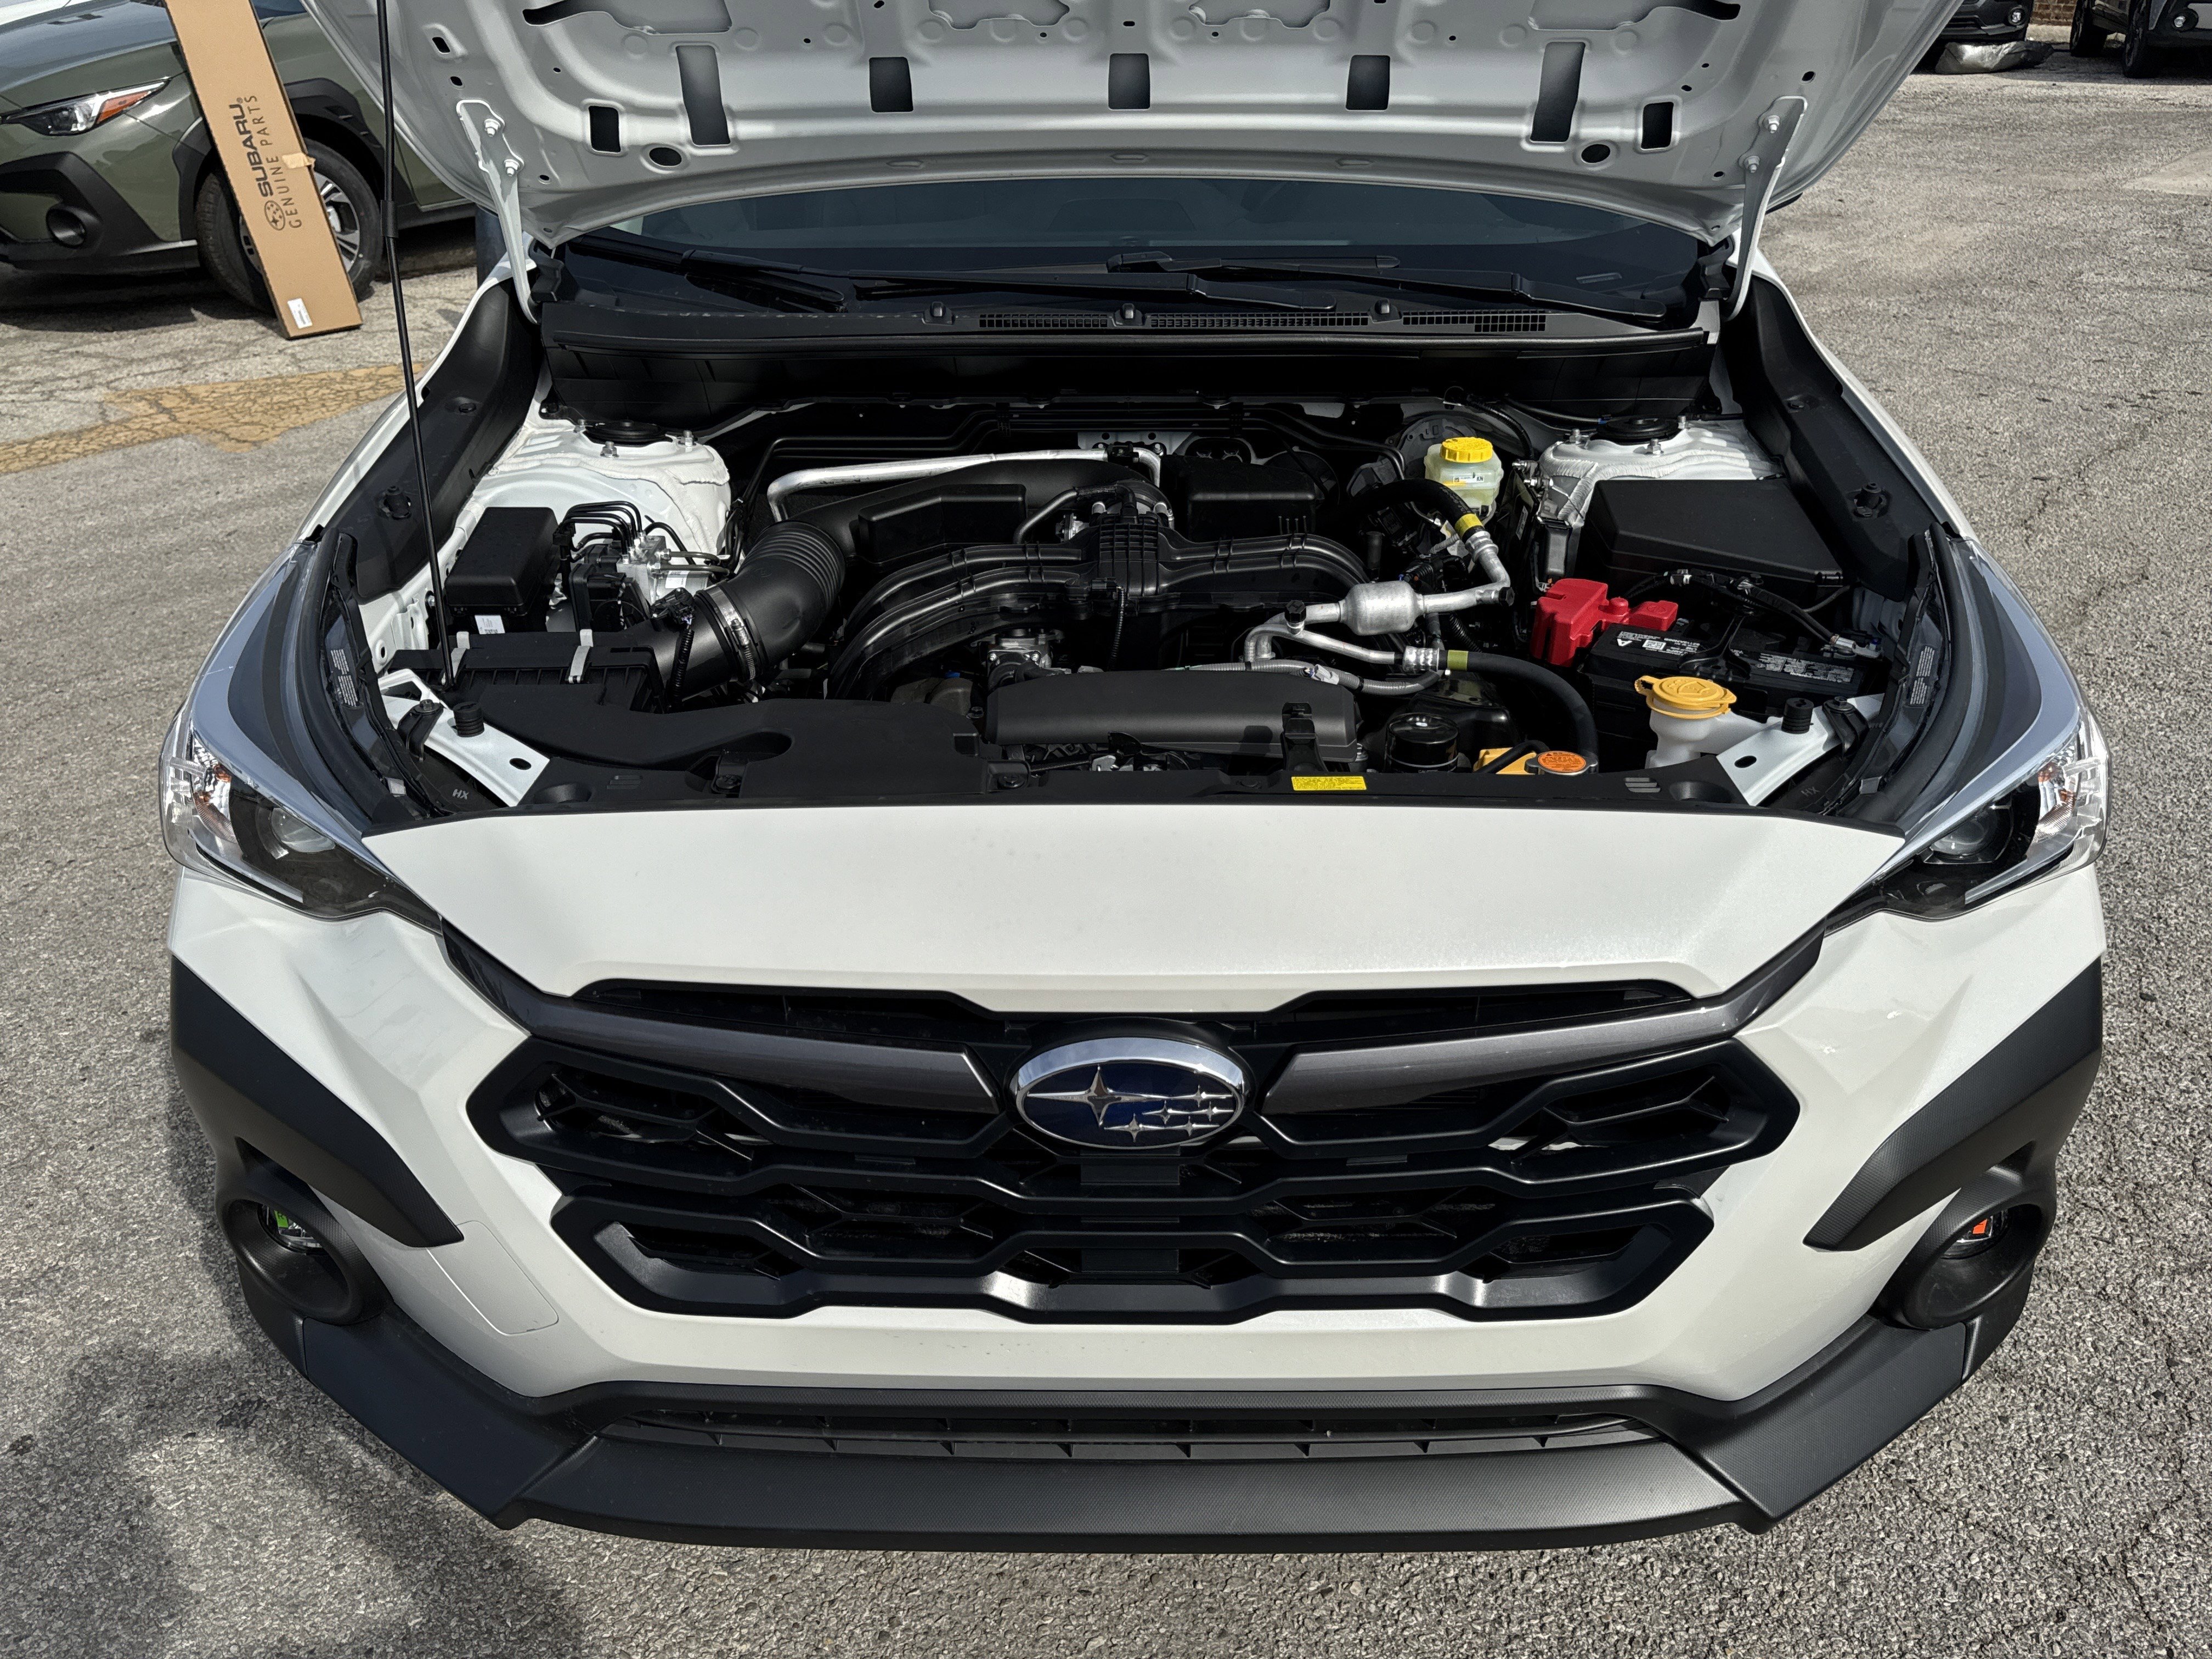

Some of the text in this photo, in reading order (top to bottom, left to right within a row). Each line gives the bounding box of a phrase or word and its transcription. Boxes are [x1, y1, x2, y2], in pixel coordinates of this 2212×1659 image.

[229, 104, 274, 198] SUBARU
[244, 95, 302, 228] GENUINE PARTS
[452, 789, 470, 800] HX
